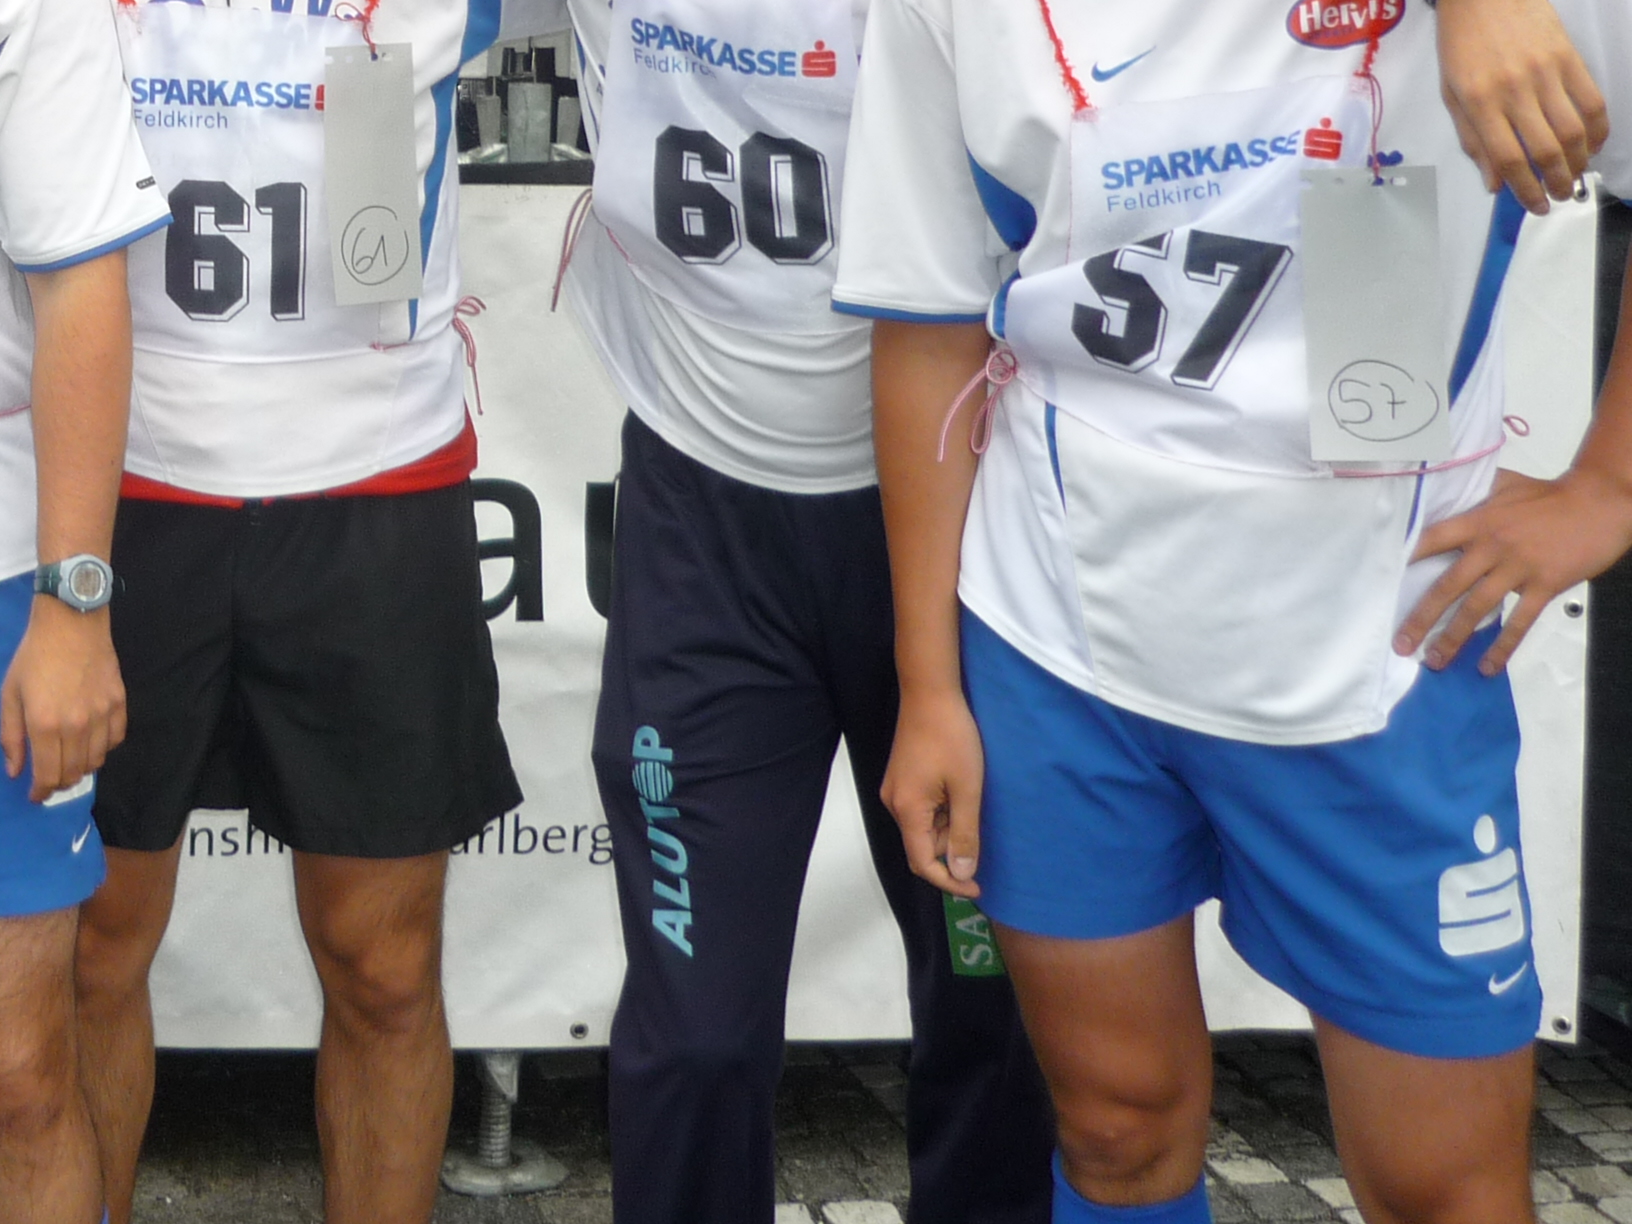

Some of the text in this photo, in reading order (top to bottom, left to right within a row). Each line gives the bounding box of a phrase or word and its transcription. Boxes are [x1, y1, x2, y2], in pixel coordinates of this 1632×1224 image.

[630, 17, 798, 78] SPARKASSE
[130, 77, 311, 111] SPARKASSE
[133, 109, 229, 130] Feldkirch
[1099, 129, 1302, 192] SPARKASSE
[652, 124, 836, 266] 60
[1105, 179, 1223, 213] Feldkirch
[164, 178, 308, 323] 61
[350, 225, 389, 275] 61
[1070, 228, 1294, 392] 57
[1338, 378, 1407, 425] 57
